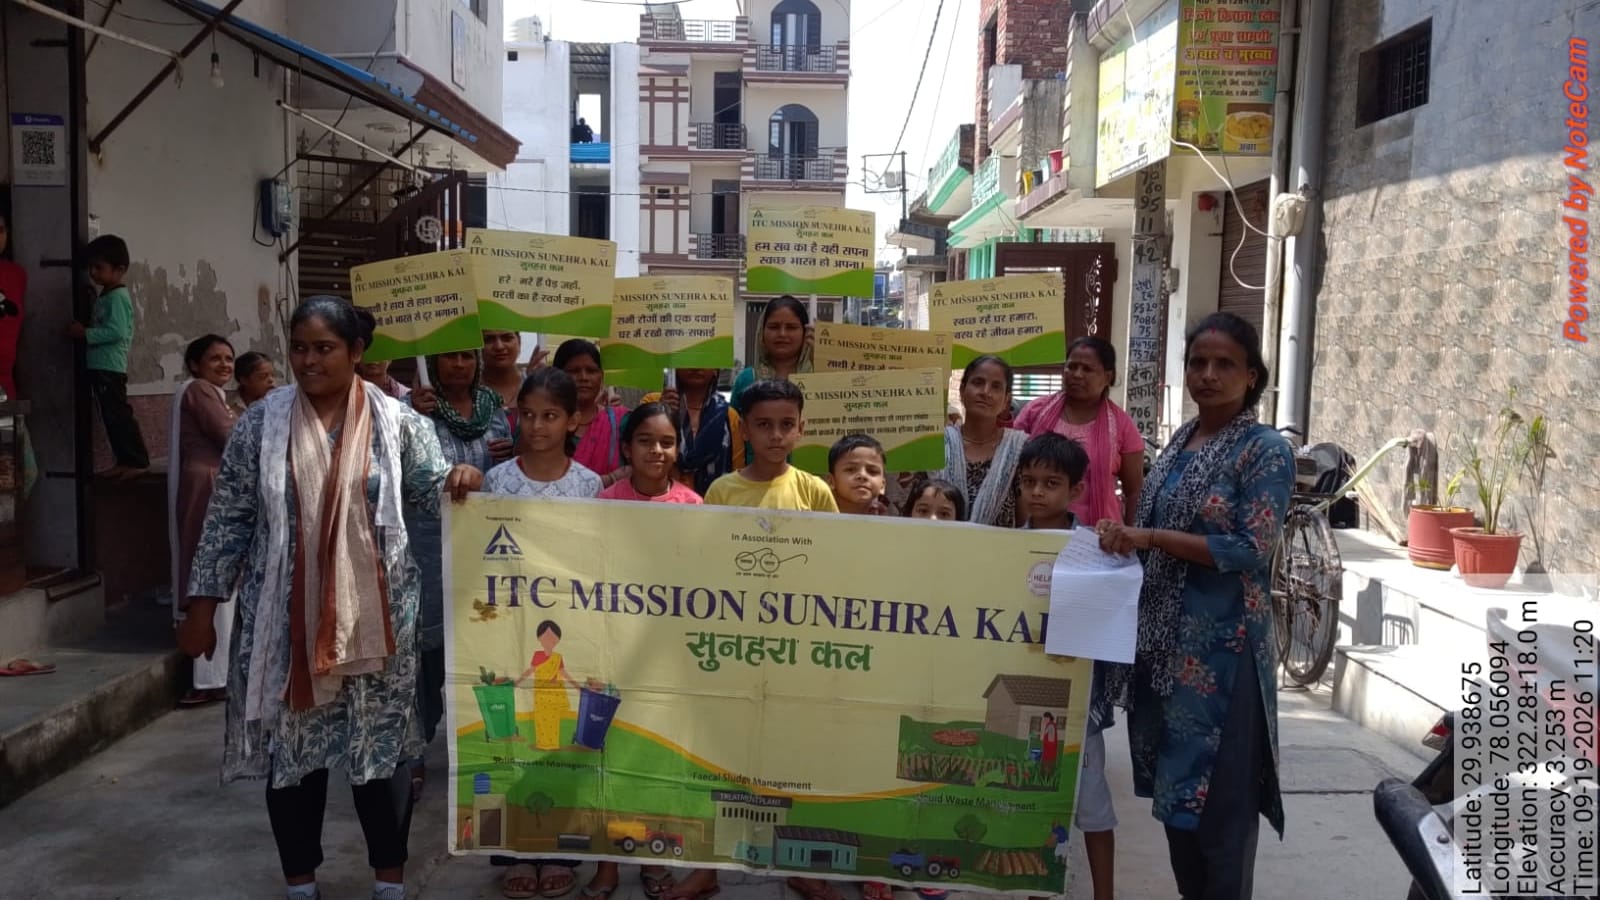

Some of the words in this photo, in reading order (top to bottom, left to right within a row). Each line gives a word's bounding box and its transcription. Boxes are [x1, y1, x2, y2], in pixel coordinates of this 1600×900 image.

[1141, 196, 1160, 212] 95
[770, 220, 809, 229] MISSION
[811, 222, 853, 232] SUNEHRA
[855, 225, 871, 234] KAL
[754, 243, 770, 252] हम
[774, 243, 790, 252] सब
[794, 244, 807, 252] का
[810, 241, 818, 253] है
[821, 243, 839, 254] यही
[843, 246, 869, 258] सपना
[469, 246, 488, 256] ITC
[490, 248, 535, 260] MISSION
[538, 252, 587, 265] SUNEHRA
[590, 257, 611, 267] KAL
[760, 256, 786, 265] स्वच्छ
[791, 257, 816, 266] भारत
[819, 257, 830, 267] हो
[368, 276, 402, 289] MISSION
[403, 270, 445, 284] SUNEHRA
[447, 267, 465, 277] KAL
[498, 274, 511, 284] हरे
[492, 289, 514, 300] धरती
[517, 292, 530, 301] का
[532, 292, 539, 302] है
[541, 293, 562, 304] स्वर्ग
[620, 293, 660, 302] MISSION
[661, 292, 707, 301] SUNEHRA
[710, 293, 728, 301] KAL
[933, 298, 949, 306] ITC
[951, 295, 989, 305] MISSION
[991, 291, 1035, 300] SUNEHRA
[1038, 288, 1058, 297] KAL
[395, 313, 412, 324] भारत
[414, 311, 422, 322] से
[617, 314, 635, 325] सभी
[660, 312, 672, 323] की
[675, 314, 692, 325] एक
[695, 312, 717, 324] दवाई
[994, 314, 1006, 323] घर
[618, 330, 631, 339] घर
[644, 327, 662, 338] रखो
[990, 326, 1015, 337] जीवन
[1017, 325, 1043, 336] हमारा
[819, 338, 835, 346] ITC
[837, 340, 876, 351] MISSION
[879, 343, 924, 354] SUNEHRA
[927, 347, 947, 355] KAL
[815, 390, 859, 400] MISSION
[861, 388, 912, 399] SUNEHRA
[915, 387, 937, 396] KAL
[1130, 407, 1151, 418] 706
[731, 533, 740, 541] In
[742, 534, 790, 544] Association
[792, 537, 813, 546] With
[484, 574, 557, 609] ITC
[568, 578, 747, 623] MISSION
[758, 590, 960, 639] SUNEHRA
[685, 632, 799, 672] सुनहरा
[811, 640, 875, 672] कल
[693, 772, 721, 782] Faecal
[752, 777, 812, 790] Management
